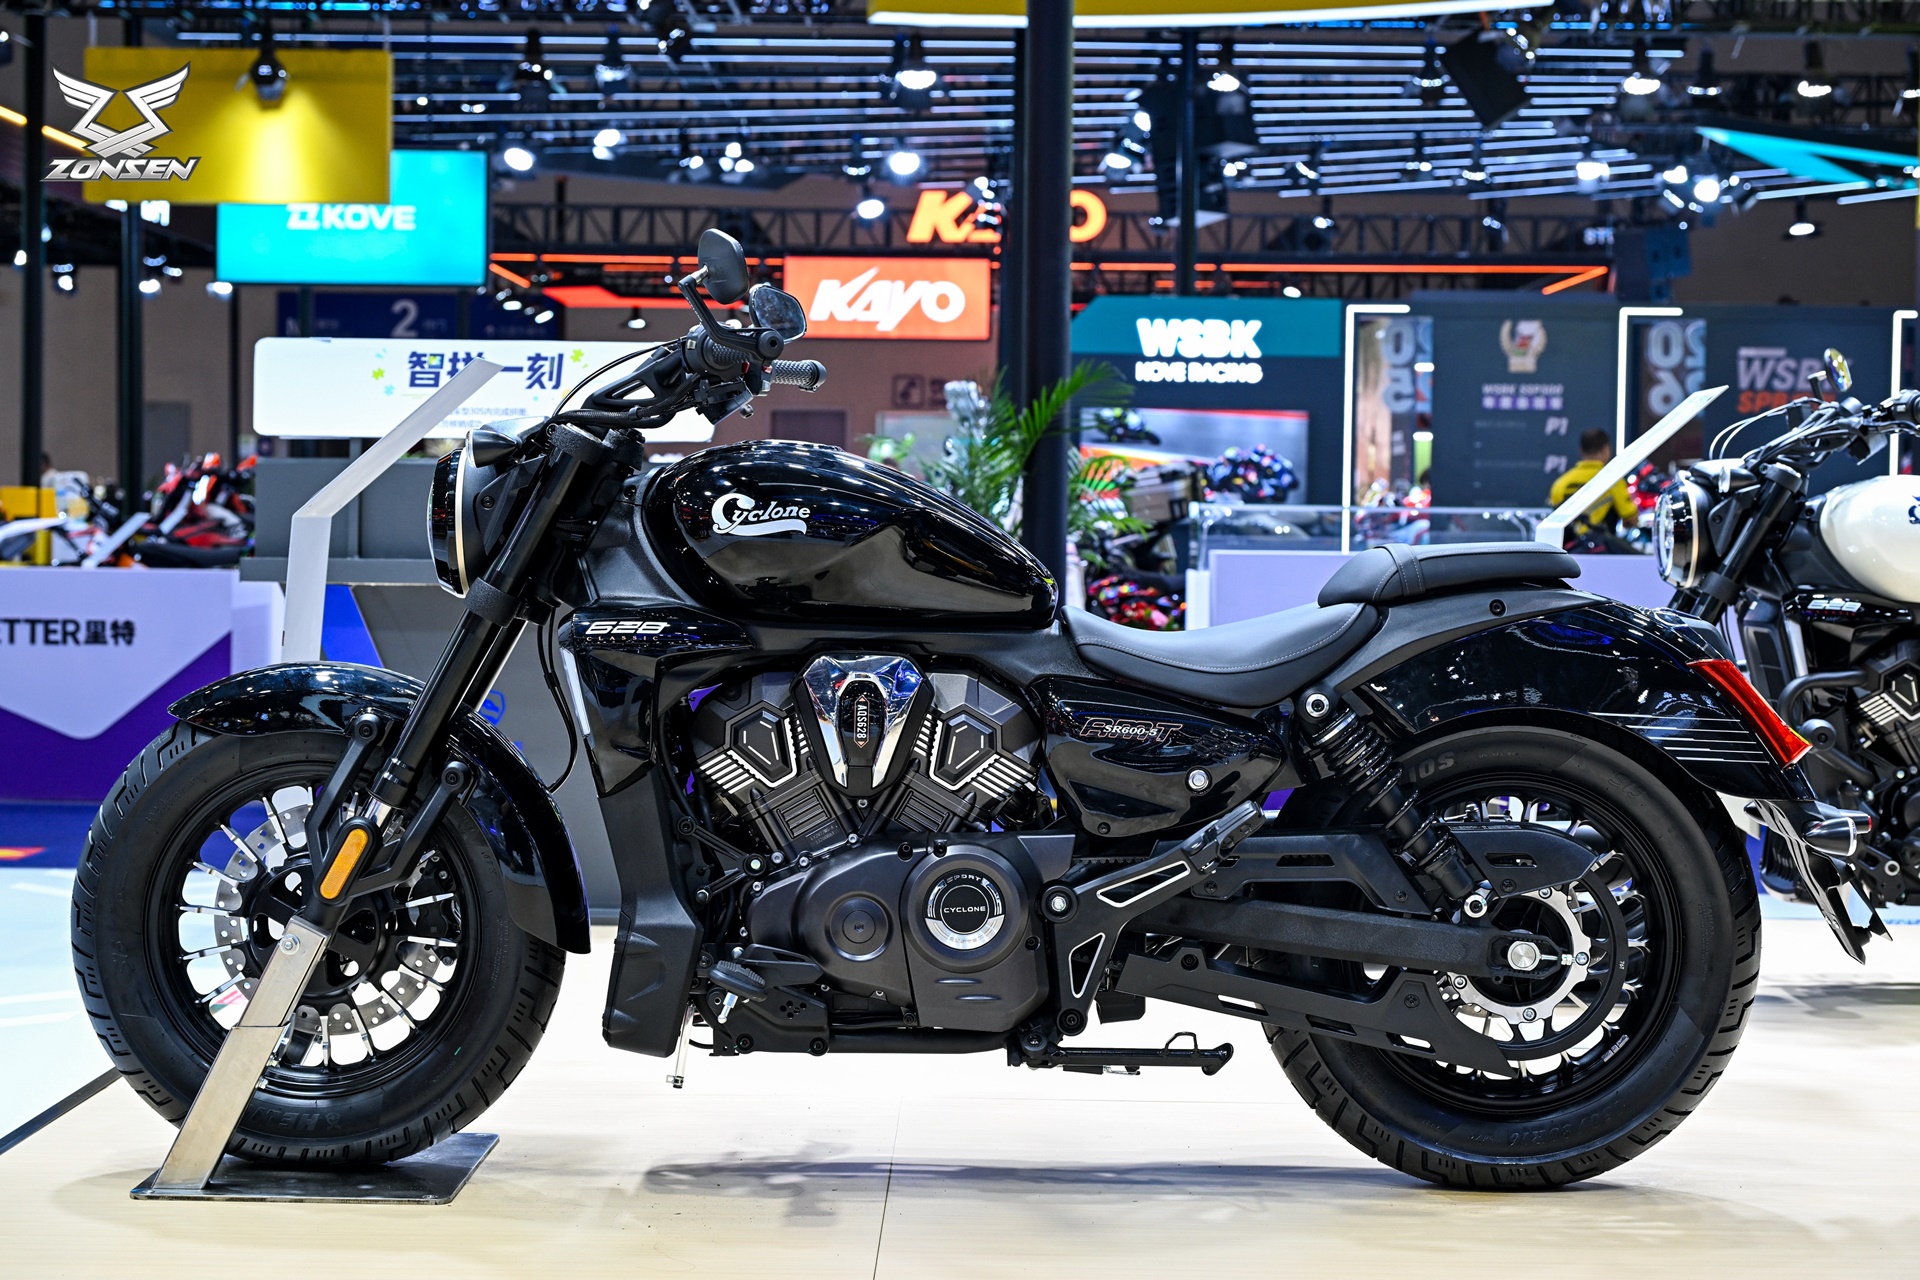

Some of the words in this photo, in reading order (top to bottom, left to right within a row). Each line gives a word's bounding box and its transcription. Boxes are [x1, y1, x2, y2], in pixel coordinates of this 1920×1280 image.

[322, 204, 416, 231] KOVE
[906, 190, 1107, 242] KO
[809, 266, 966, 332] KAYO
[391, 299, 419, 338] 2
[1136, 318, 1262, 358] WSBK
[1738, 356, 1852, 390] WSB
[711, 493, 811, 535] Cyclone
[1807, 599, 1861, 613] 628
[0, 619, 135, 646] TTER里特
[585, 621, 669, 634] 628
[857, 704, 868, 739] AQS628
[946, 874, 981, 883] SPORT
[943, 905, 986, 913] CYCLONE
